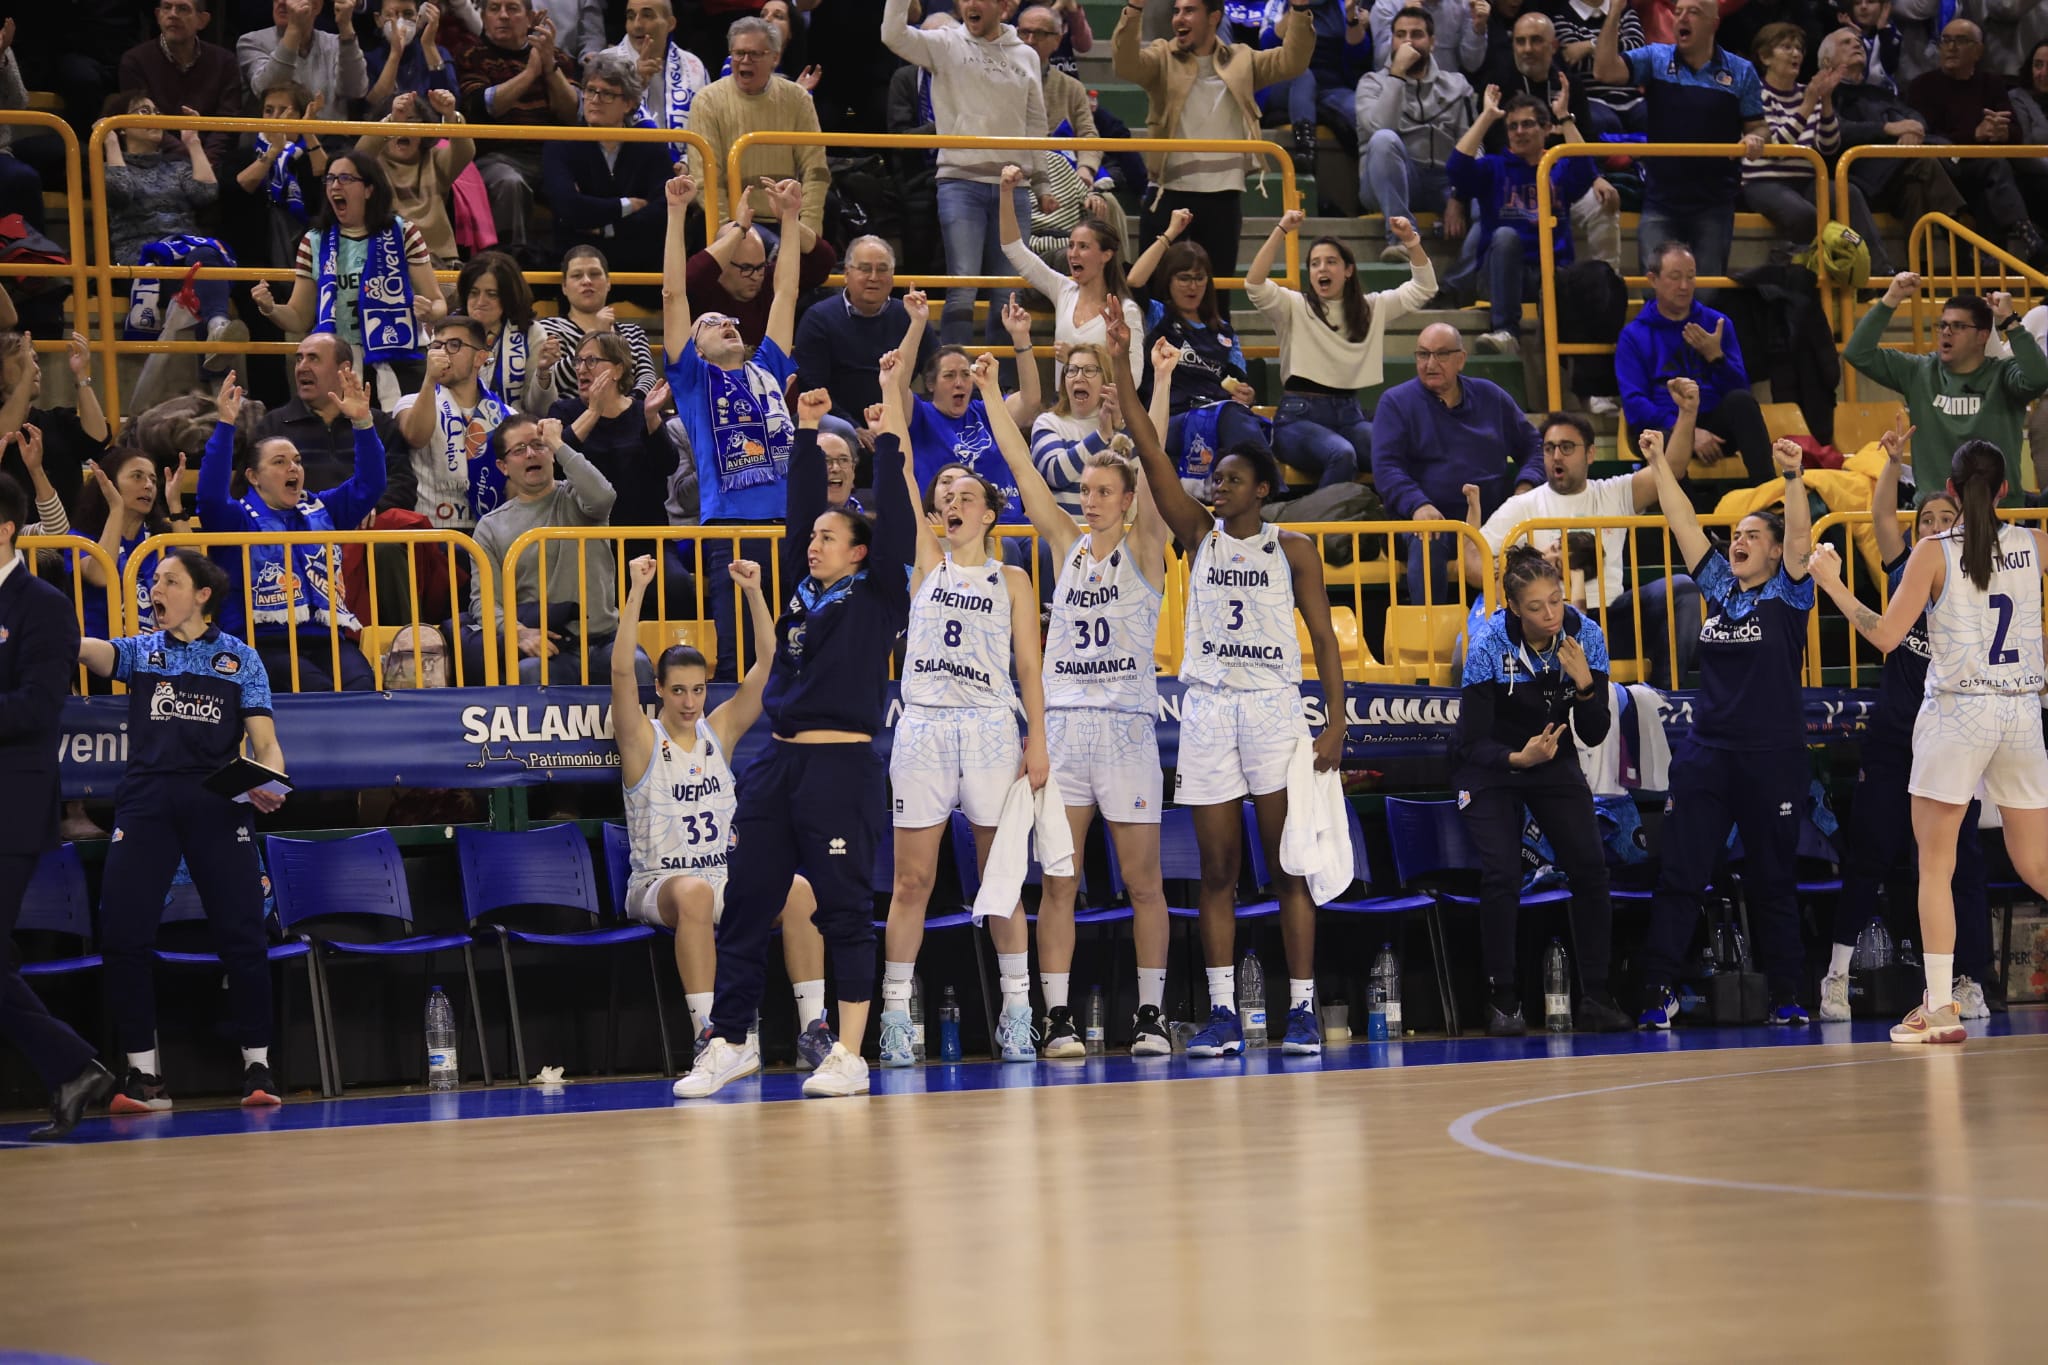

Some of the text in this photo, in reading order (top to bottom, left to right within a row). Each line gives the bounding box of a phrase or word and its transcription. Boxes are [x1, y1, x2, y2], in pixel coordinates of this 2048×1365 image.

[1932, 394, 1981, 416] PUMA
[727, 455, 766, 469] AVENIDA
[1227, 600, 1244, 630] 3
[1989, 593, 2020, 665] 2
[944, 620, 962, 647] 8
[1075, 617, 1110, 649] 30
[529, 751, 621, 767] Patrimonio de
[682, 811, 718, 845] 33
